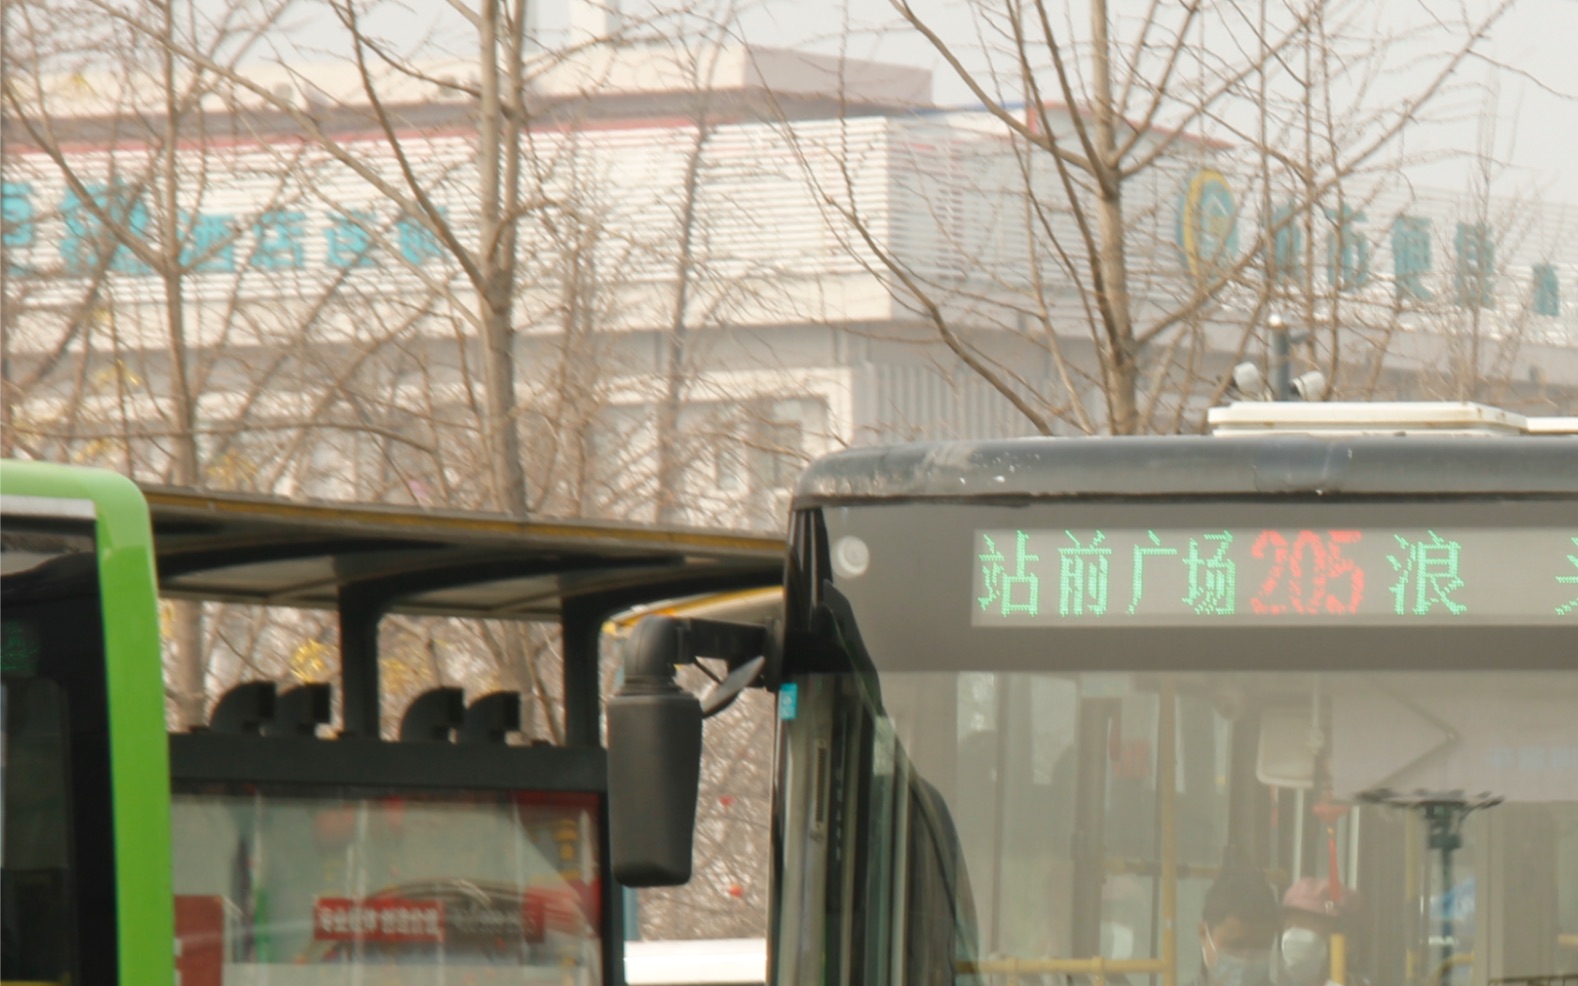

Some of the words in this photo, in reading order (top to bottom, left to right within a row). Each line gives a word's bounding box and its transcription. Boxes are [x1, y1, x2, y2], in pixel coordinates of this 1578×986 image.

[979, 530, 1235, 617] 站前广场
[1250, 530, 1364, 614] 205
